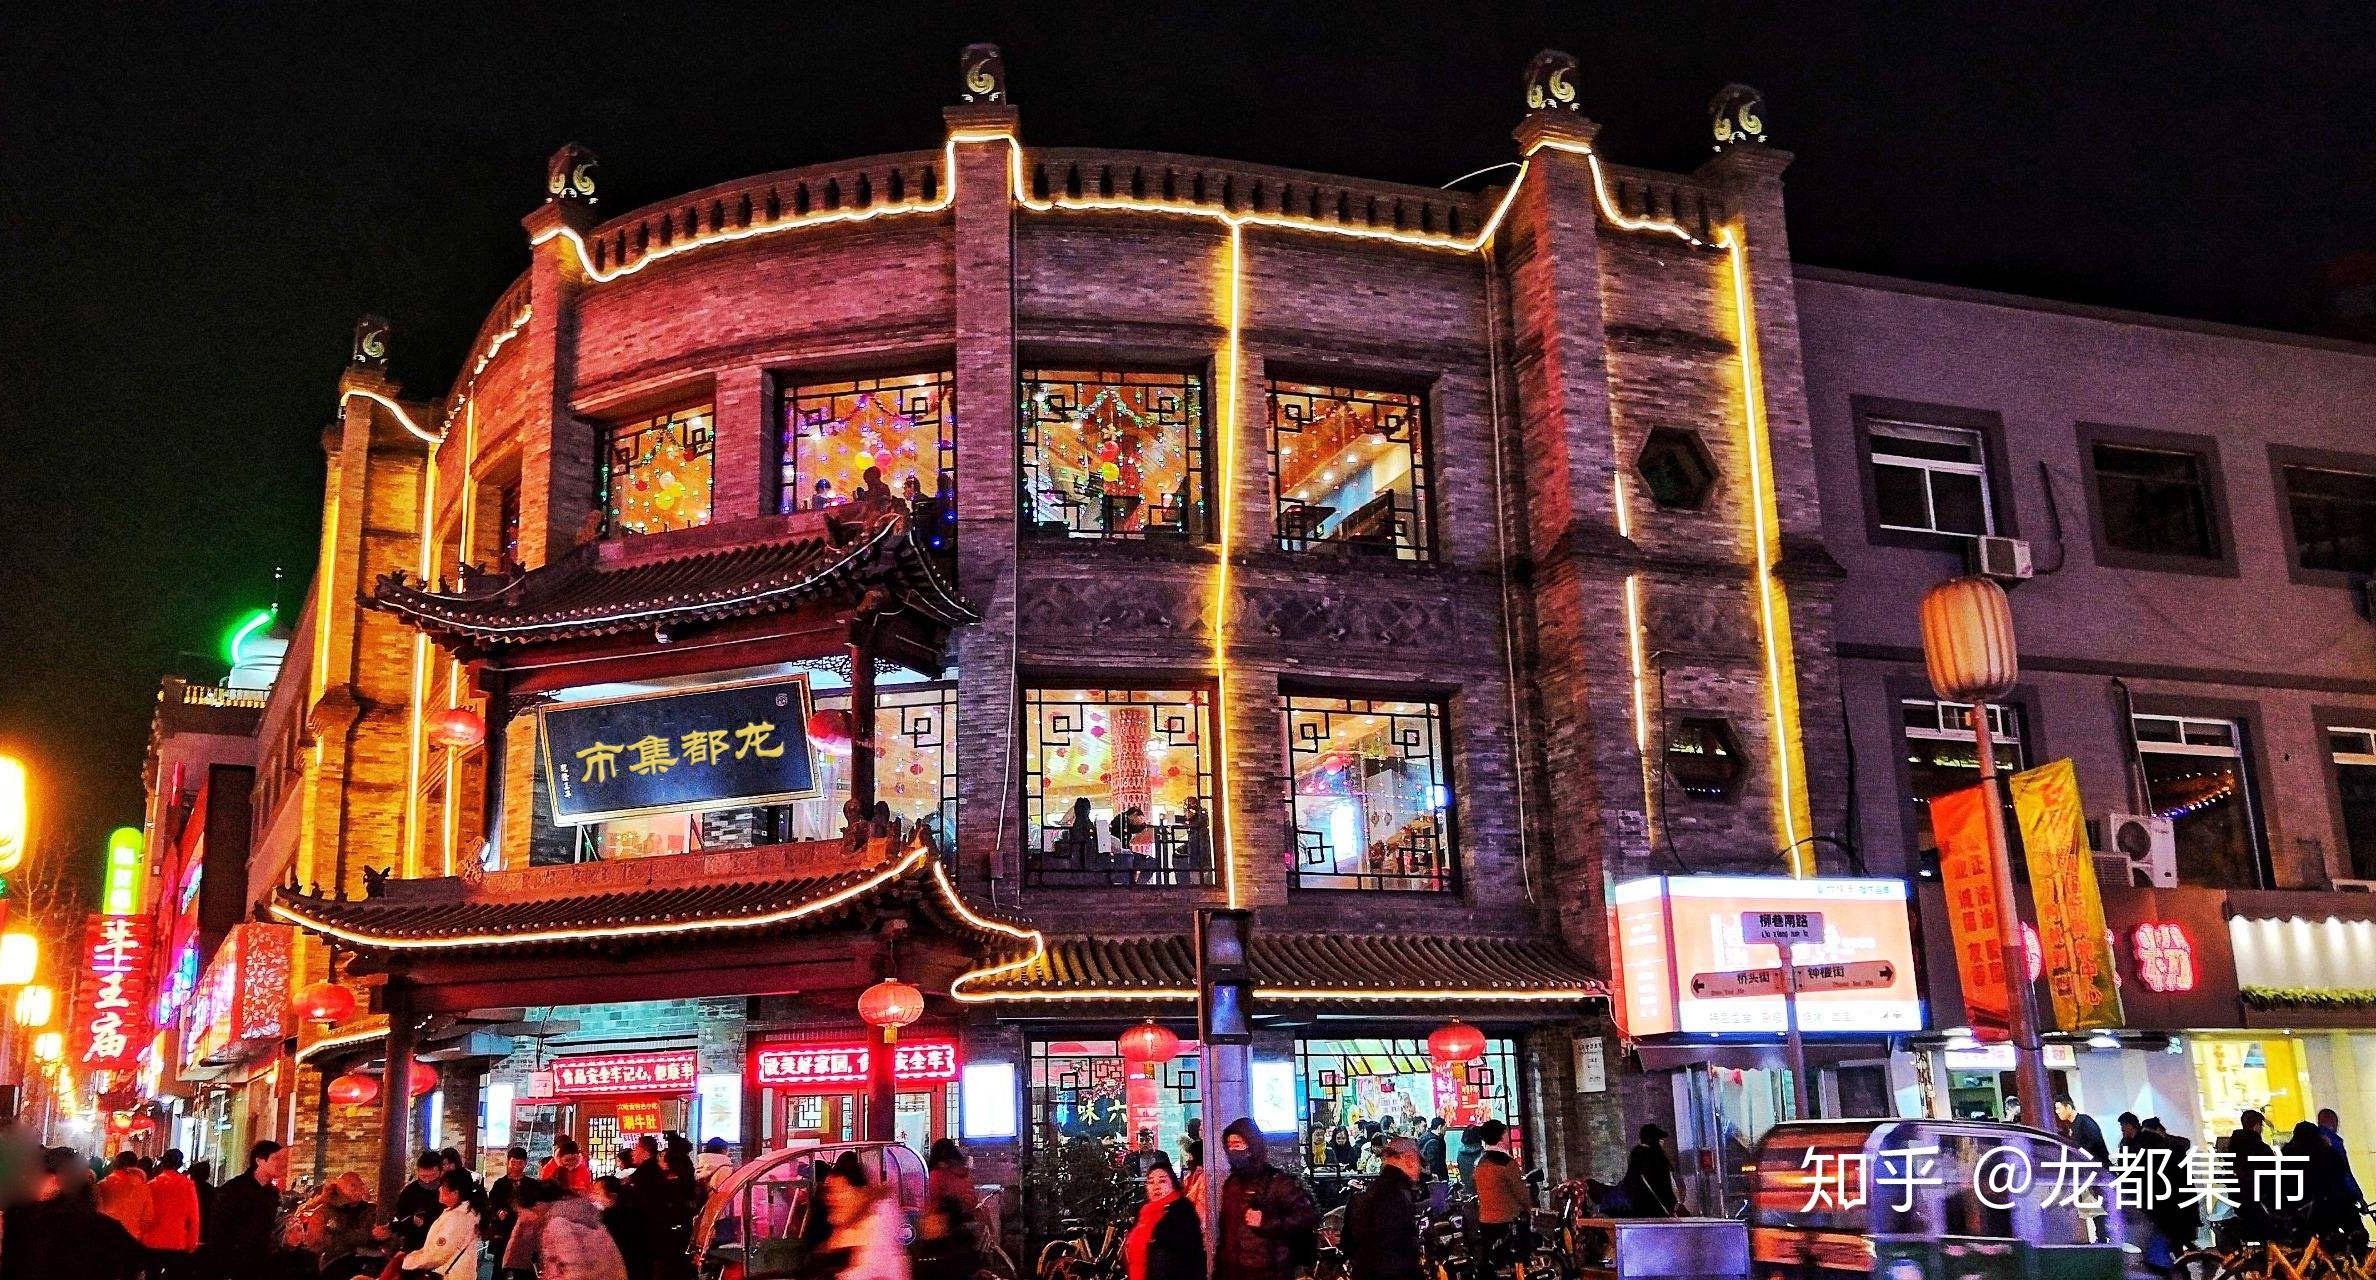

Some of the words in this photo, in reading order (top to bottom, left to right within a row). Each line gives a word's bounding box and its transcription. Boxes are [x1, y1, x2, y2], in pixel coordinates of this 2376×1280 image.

[576, 721, 785, 784] 龙都集市
[1759, 914, 1809, 928] 柳巷南路
